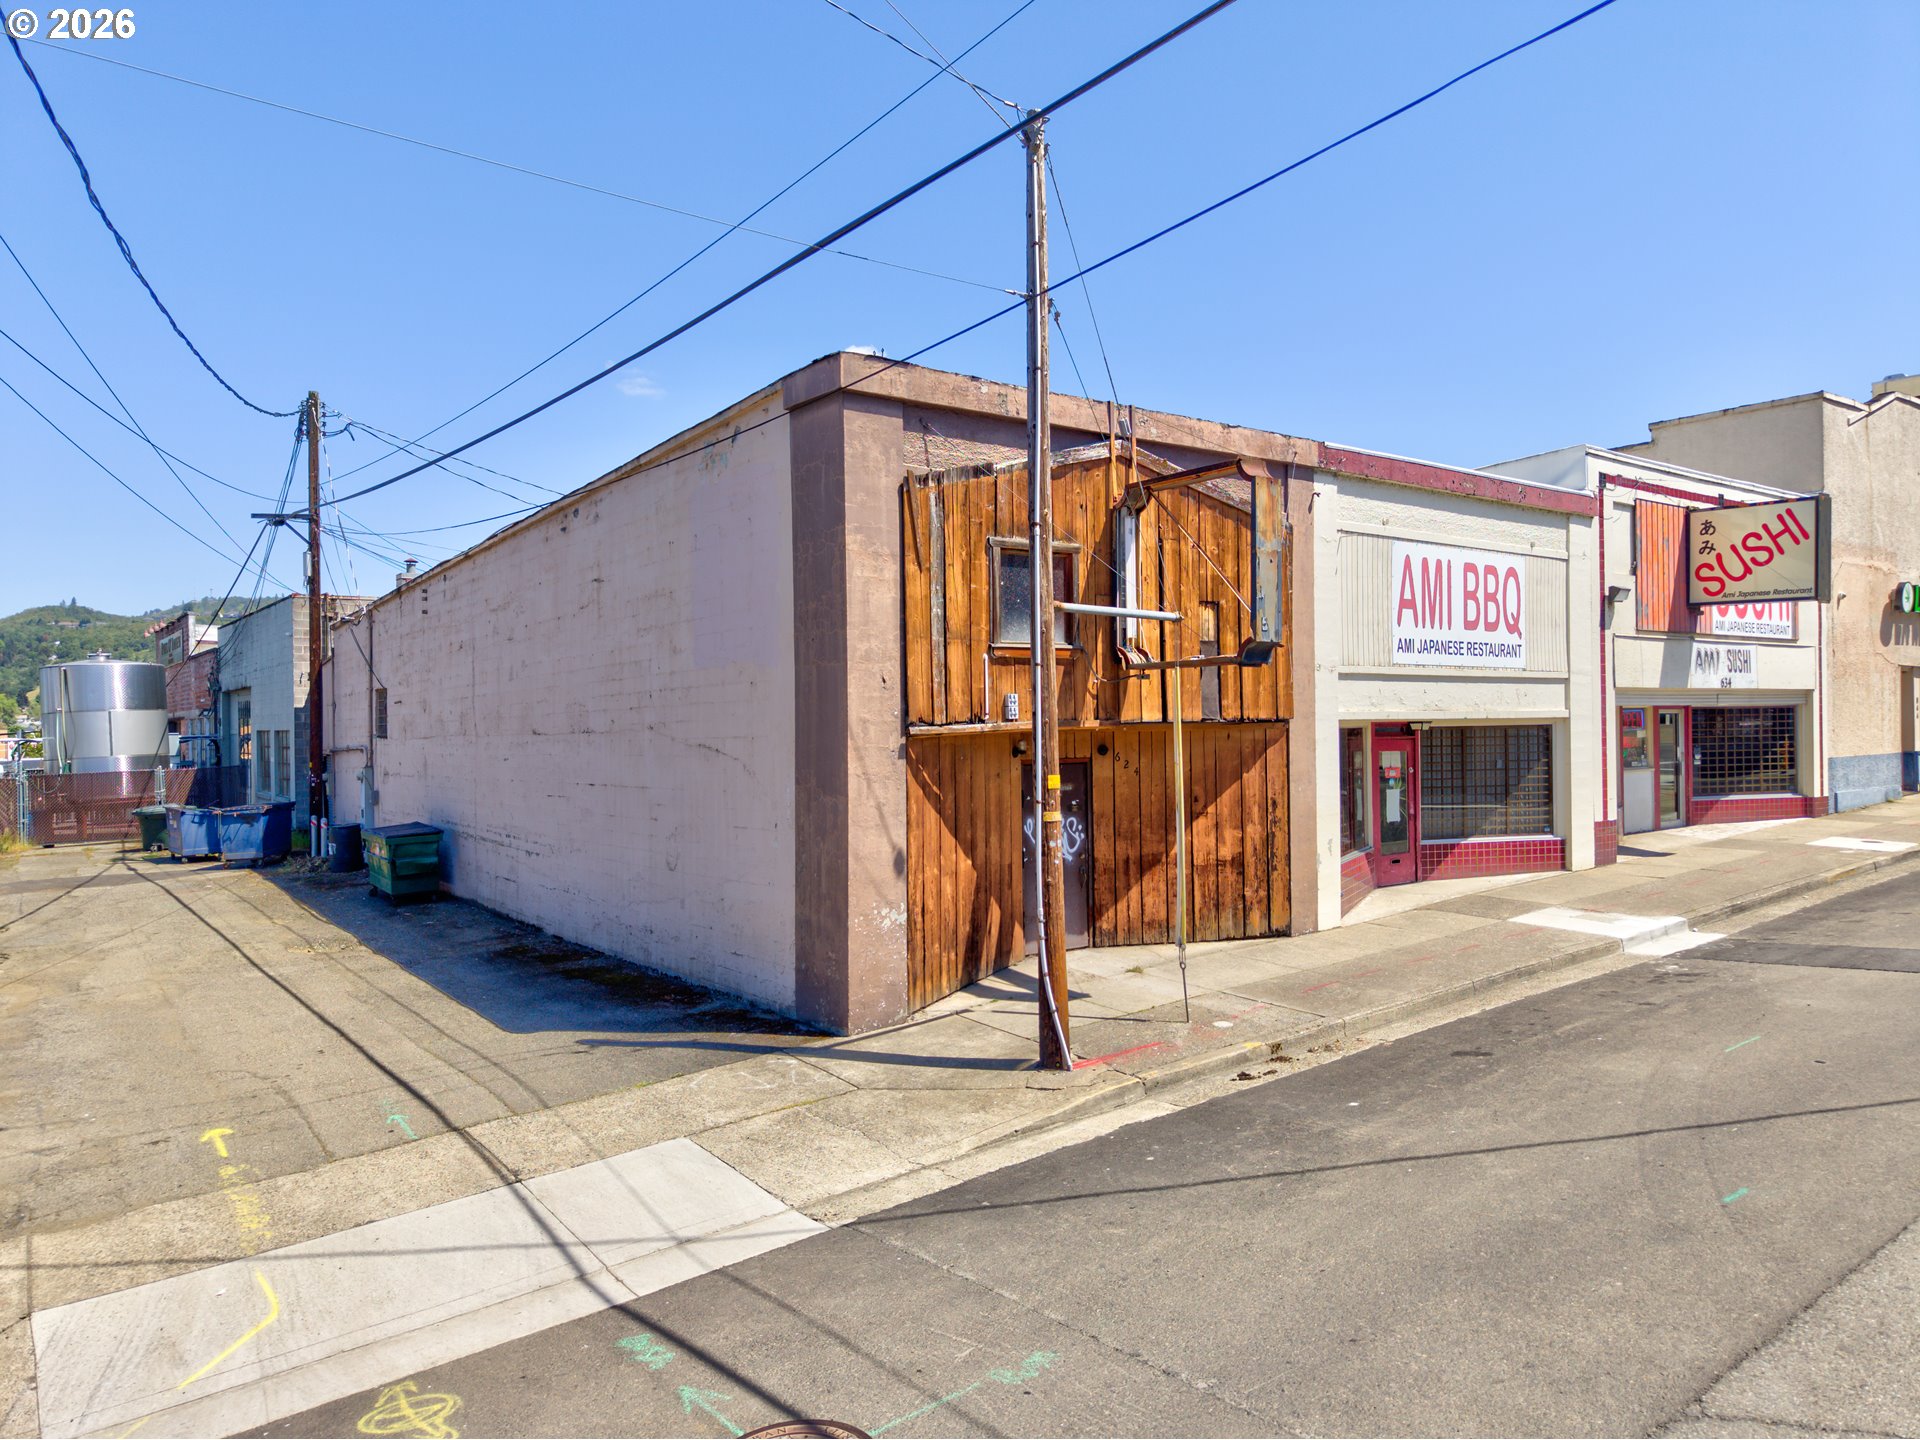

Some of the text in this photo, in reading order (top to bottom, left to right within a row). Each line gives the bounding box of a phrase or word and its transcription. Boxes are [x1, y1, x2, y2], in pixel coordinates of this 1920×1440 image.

[1699, 520, 1716, 555] あみ
[1695, 508, 1810, 597] SUSHI
[1397, 554, 1522, 640] AMI BBQ
[1722, 587, 1813, 599] Ami Japanese Restaurant
[1715, 620, 1790, 635] AMI JAPANESE RESTAURANT
[1397, 638, 1522, 658] AMI JAPANESE RESTAURANT
[1695, 648, 1751, 675] AMI SUSHI
[1720, 677, 1732, 689] 634
[1115, 751, 1139, 776] 624
